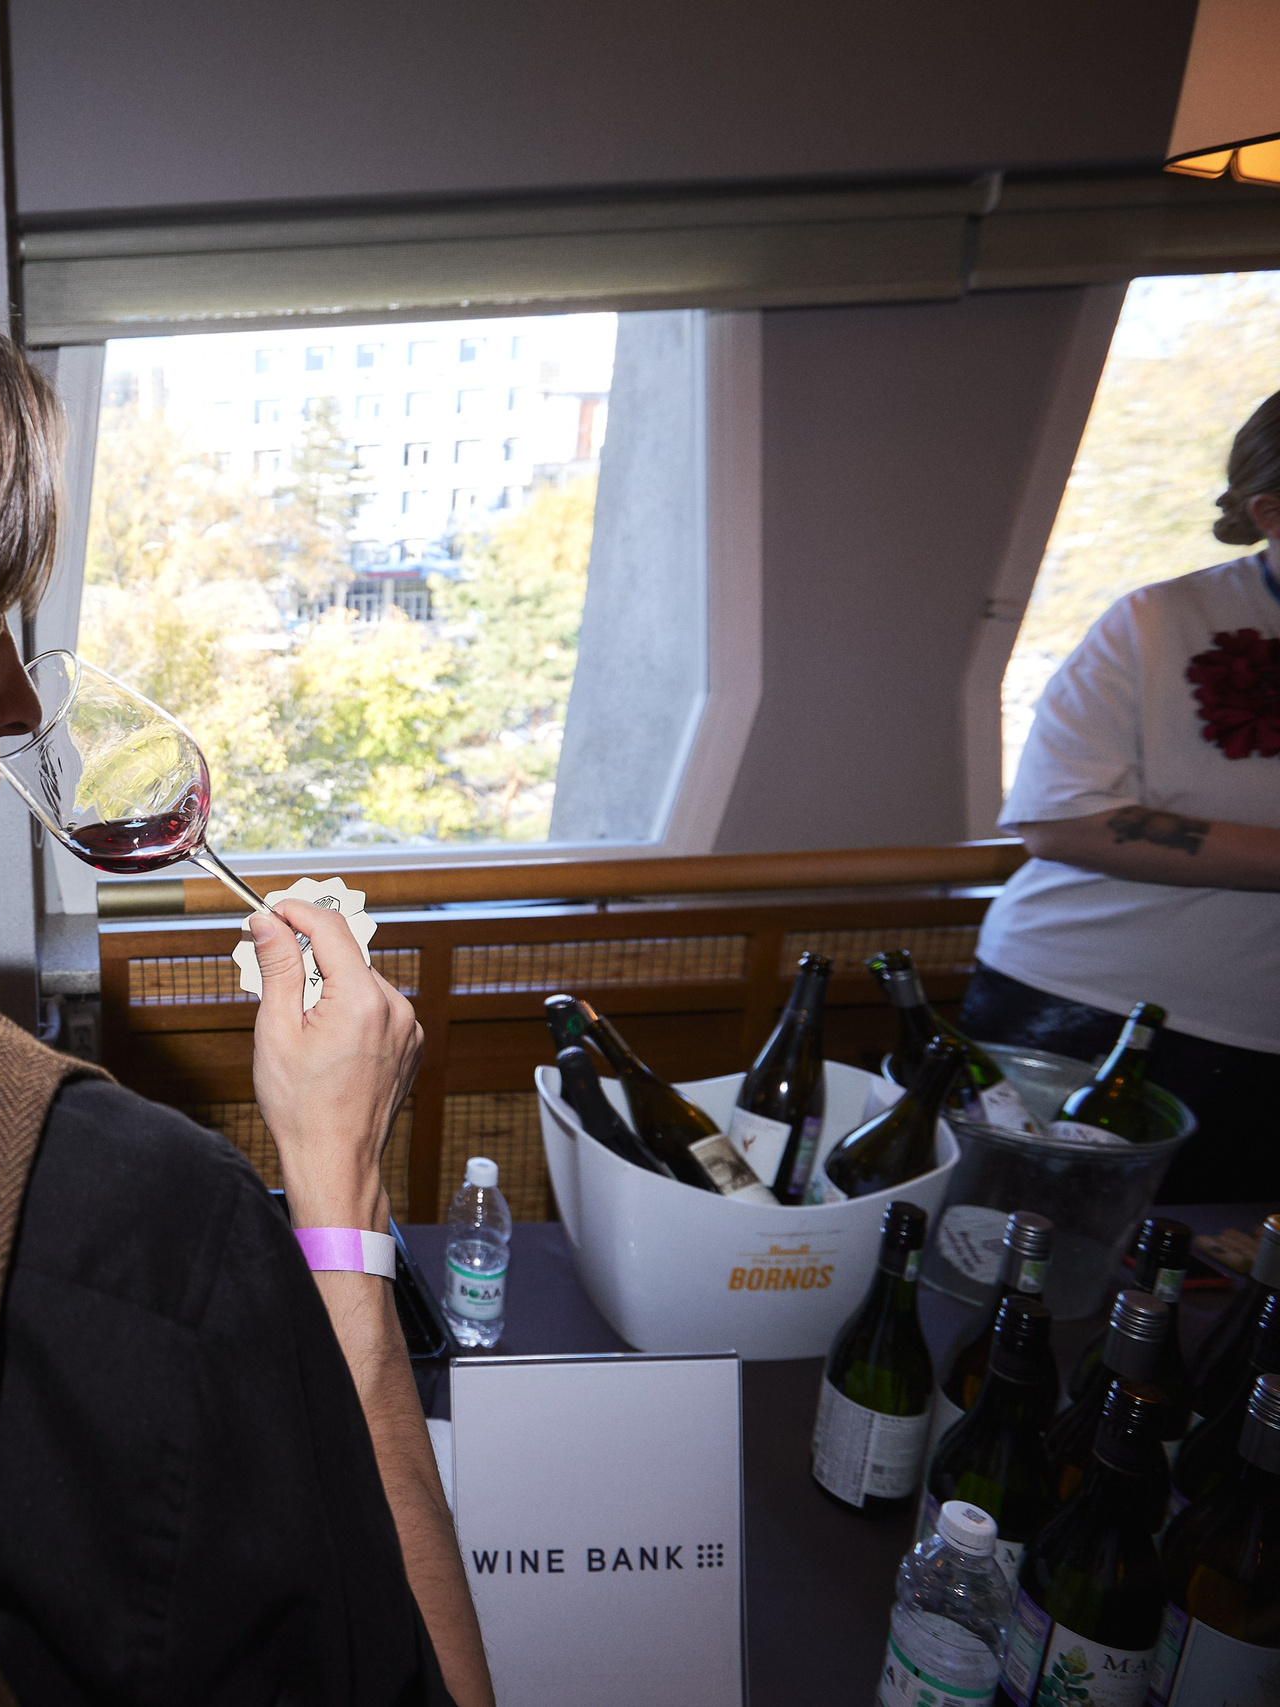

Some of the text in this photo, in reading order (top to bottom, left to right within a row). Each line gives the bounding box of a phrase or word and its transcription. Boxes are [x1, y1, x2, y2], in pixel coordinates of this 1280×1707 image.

[728, 1264, 835, 1291] BORNOS
[472, 1545, 683, 1574] WINE BANK
